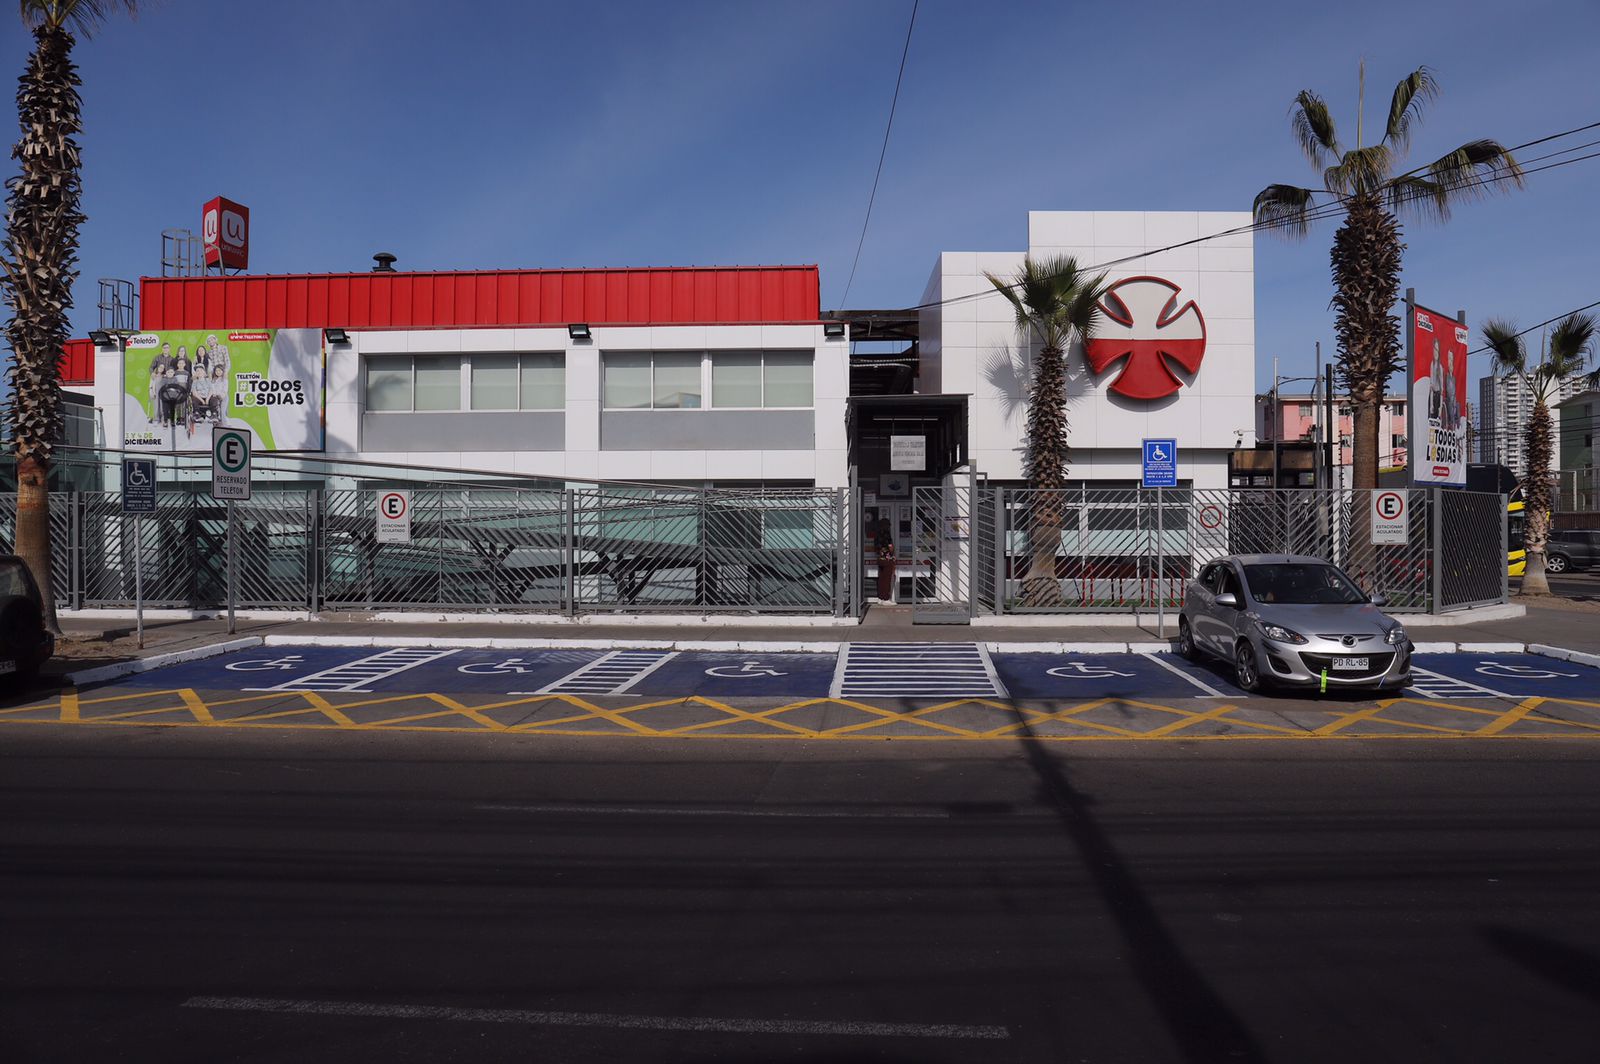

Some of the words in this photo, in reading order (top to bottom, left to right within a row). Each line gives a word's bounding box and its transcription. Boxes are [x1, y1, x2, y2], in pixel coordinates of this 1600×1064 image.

[226, 441, 238, 464] E
[216, 475, 247, 485] RESERVADO
[389, 498, 398, 514] E
[1384, 497, 1395, 514] E
